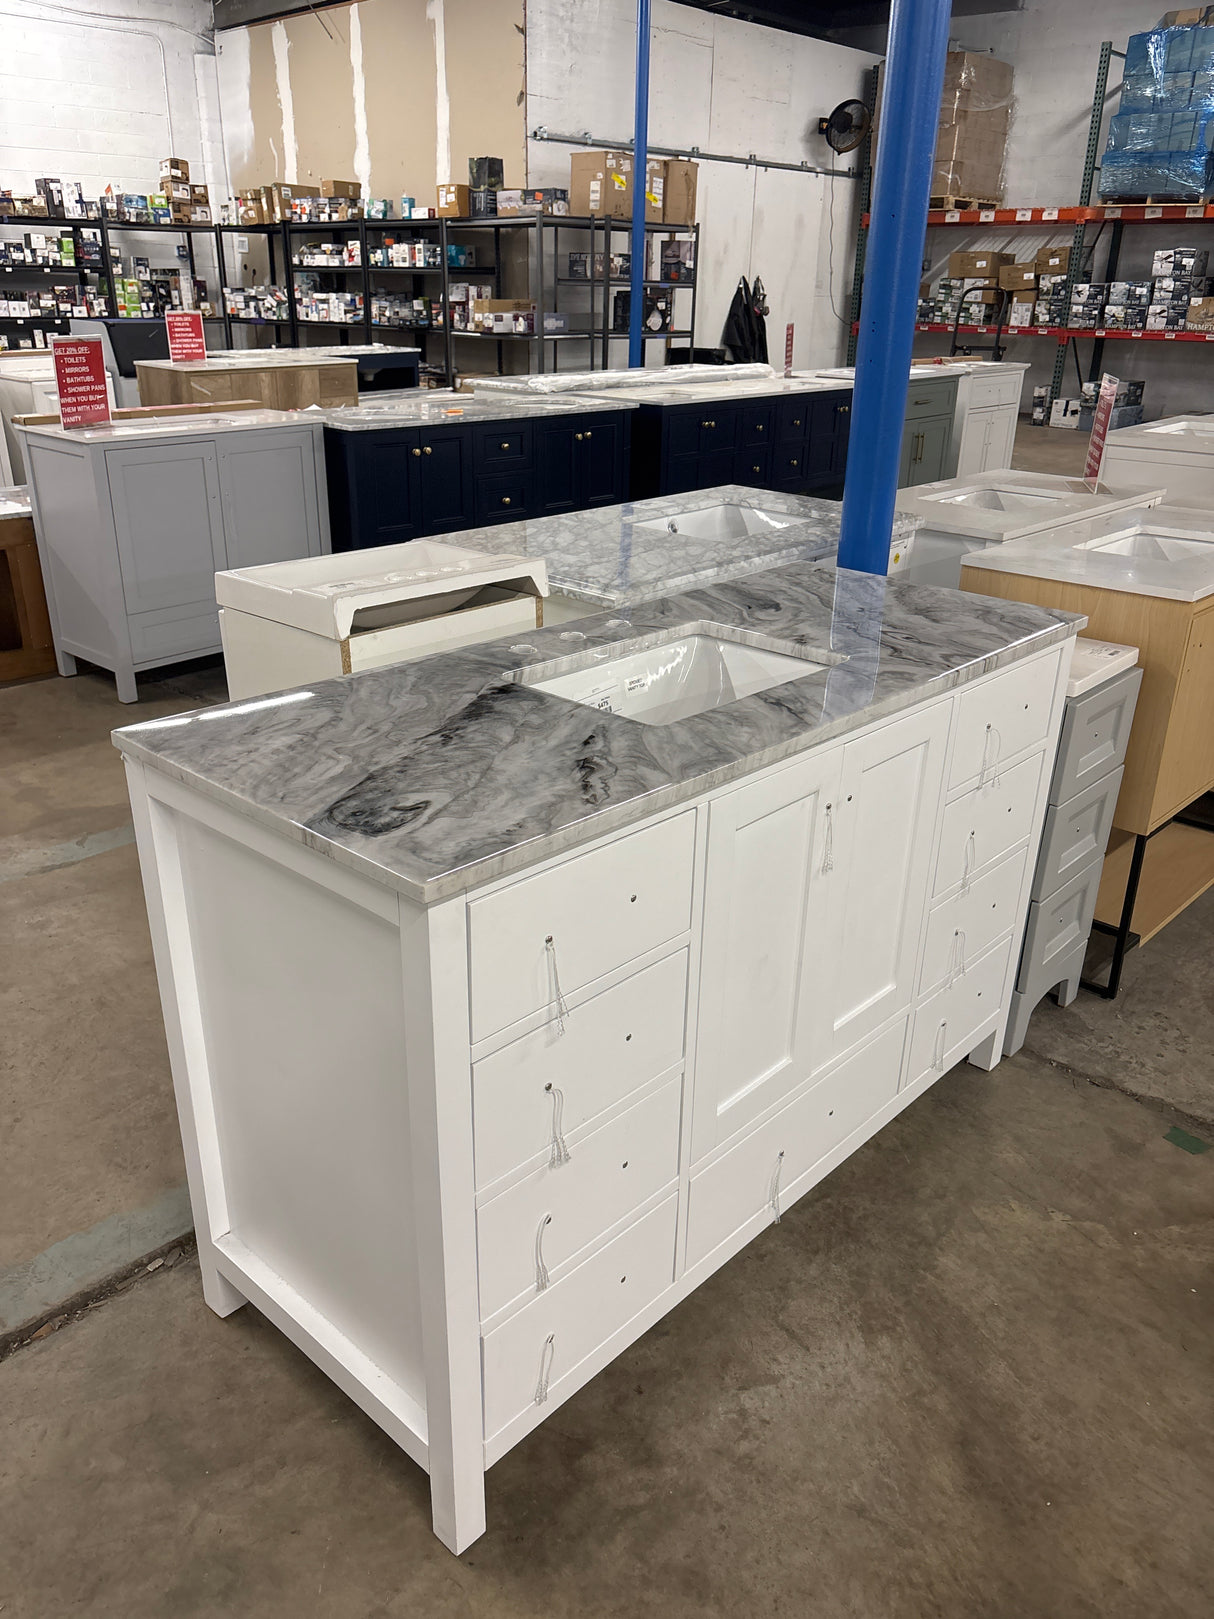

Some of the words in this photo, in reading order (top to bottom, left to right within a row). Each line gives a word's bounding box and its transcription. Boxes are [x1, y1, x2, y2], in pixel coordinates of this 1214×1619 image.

[65, 366, 89, 374] MIRRORS
[66, 376, 94, 384] BATHTUBS
[63, 415, 82, 423] VANITY
